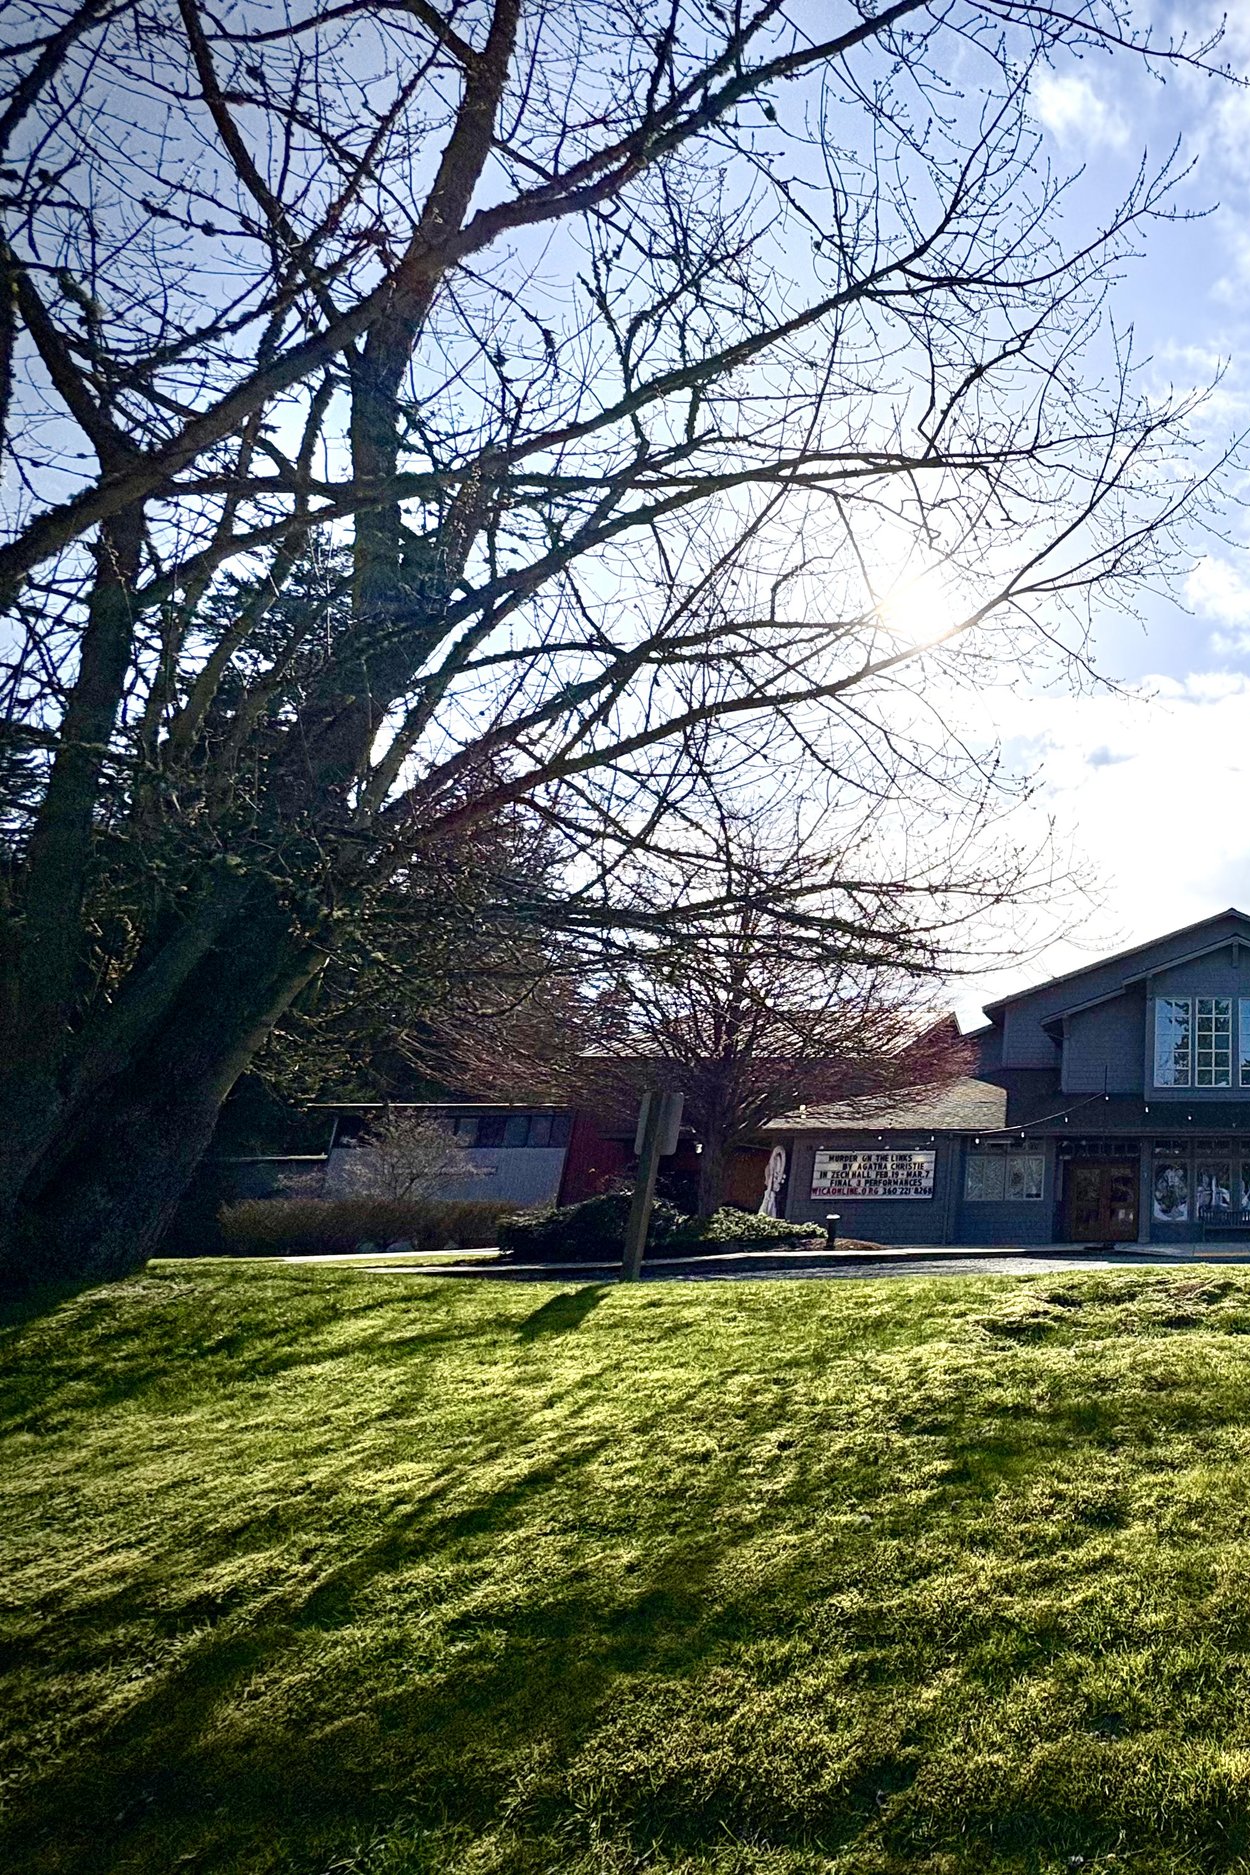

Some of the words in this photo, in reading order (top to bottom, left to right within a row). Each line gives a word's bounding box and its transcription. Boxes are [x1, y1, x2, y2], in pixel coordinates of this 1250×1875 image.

[828, 1154, 858, 1162] MURDER
[862, 1154, 872, 1162] ON
[876, 1154, 889, 1162] THE
[891, 1154, 913, 1162] LINKS
[842, 1163, 852, 1171] BY
[820, 1171, 828, 1179] IN
[831, 1171, 849, 1179] ZECH
[829, 1179, 852, 1187] FINAL
[864, 1179, 923, 1187] PERFORMANCES
